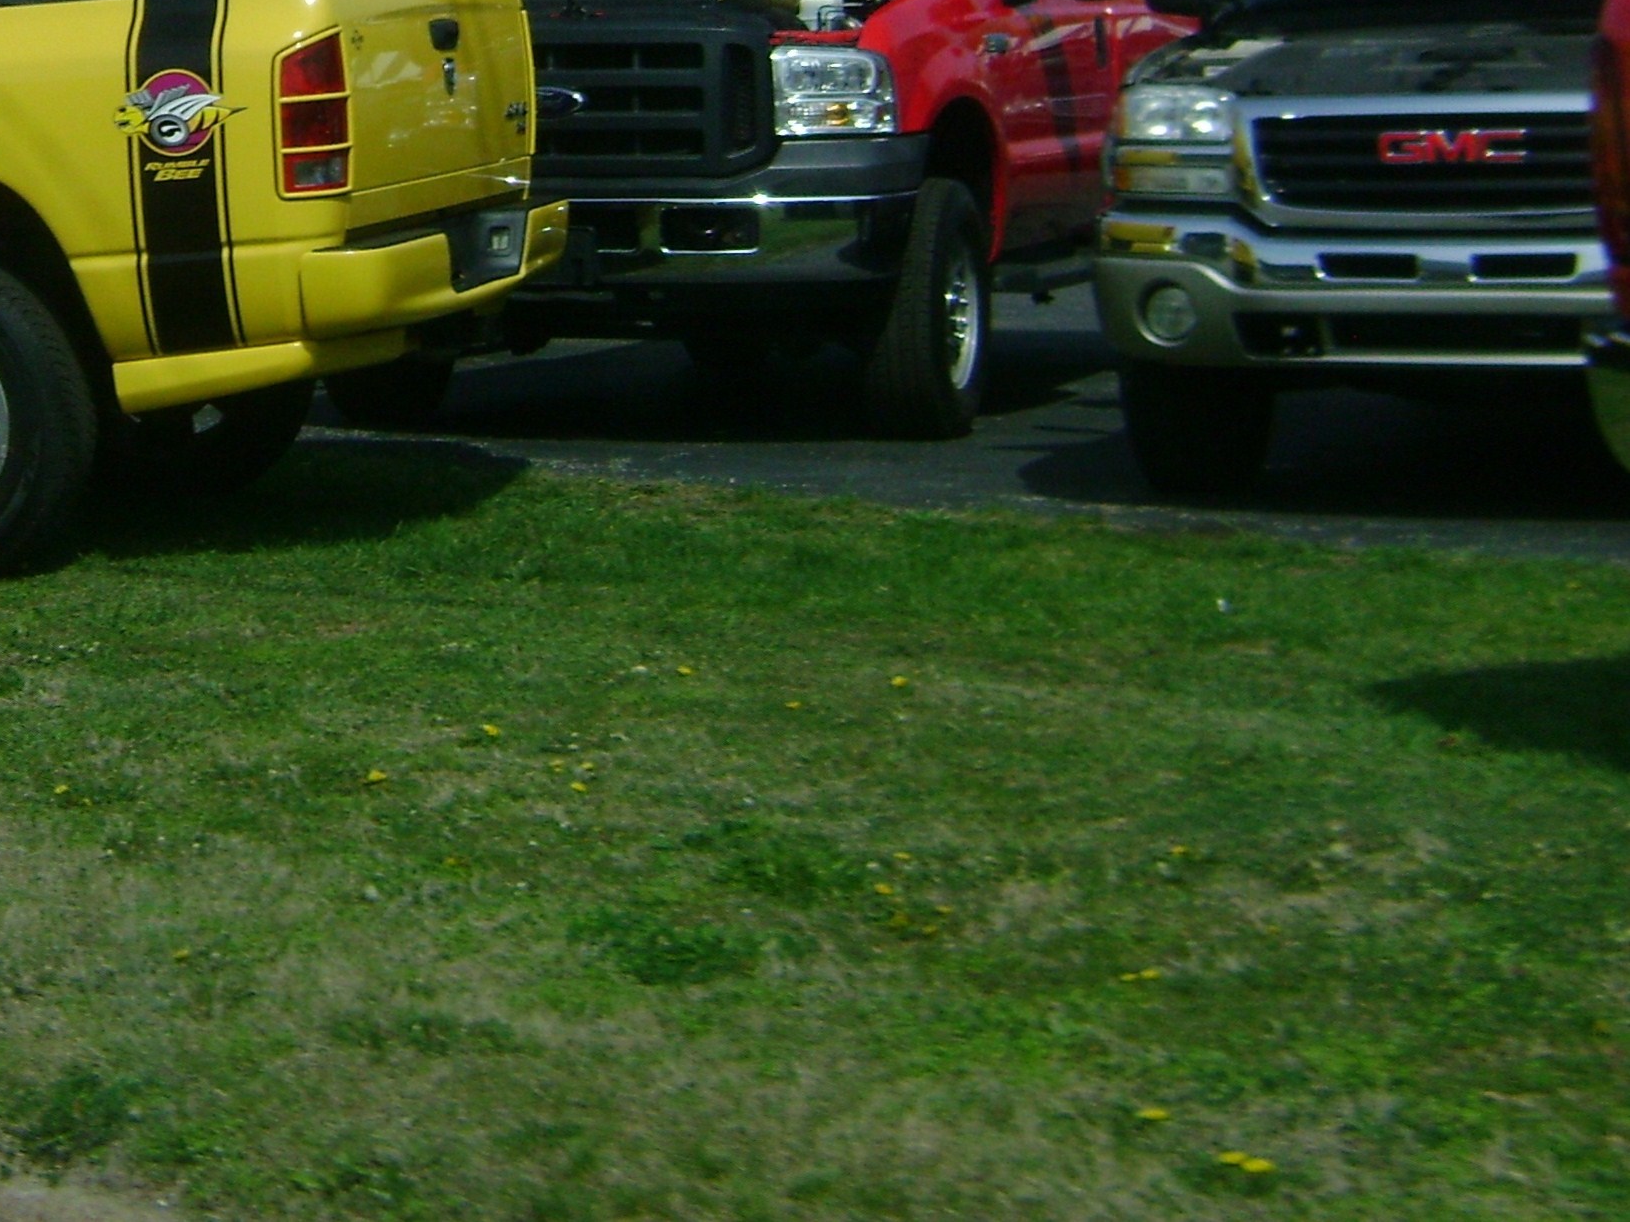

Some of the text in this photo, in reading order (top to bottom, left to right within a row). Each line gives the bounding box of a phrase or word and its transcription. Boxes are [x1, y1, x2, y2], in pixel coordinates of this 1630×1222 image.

[1377, 129, 1528, 164] GMC
[144, 158, 210, 171] RUMBLE
[154, 168, 204, 181] BEE
